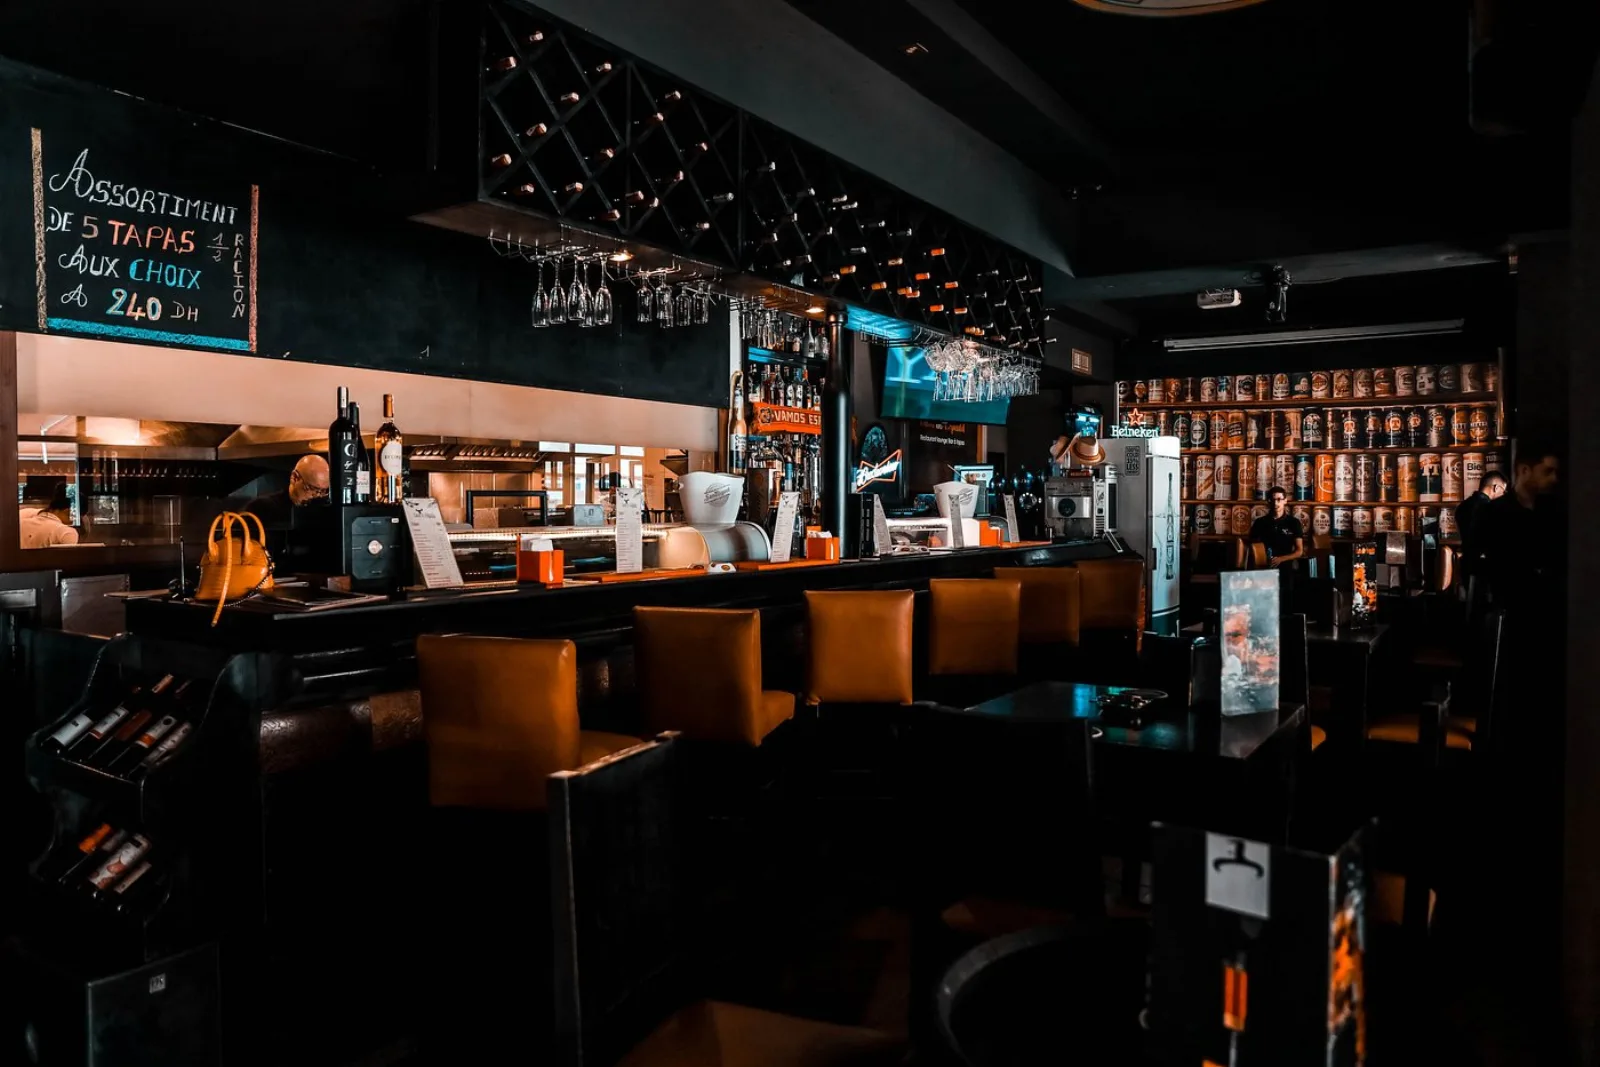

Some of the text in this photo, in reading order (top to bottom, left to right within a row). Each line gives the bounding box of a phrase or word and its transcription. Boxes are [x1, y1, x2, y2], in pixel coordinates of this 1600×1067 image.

[49, 148, 239, 225] ASSORTIMENT
[46, 206, 196, 254] DE 5 TAPAS
[58, 243, 201, 289] AUX CHOIX
[61, 283, 199, 322] A 240 DH
[774, 410, 806, 424] VAMOS
[1110, 425, 1159, 438] Heineken
